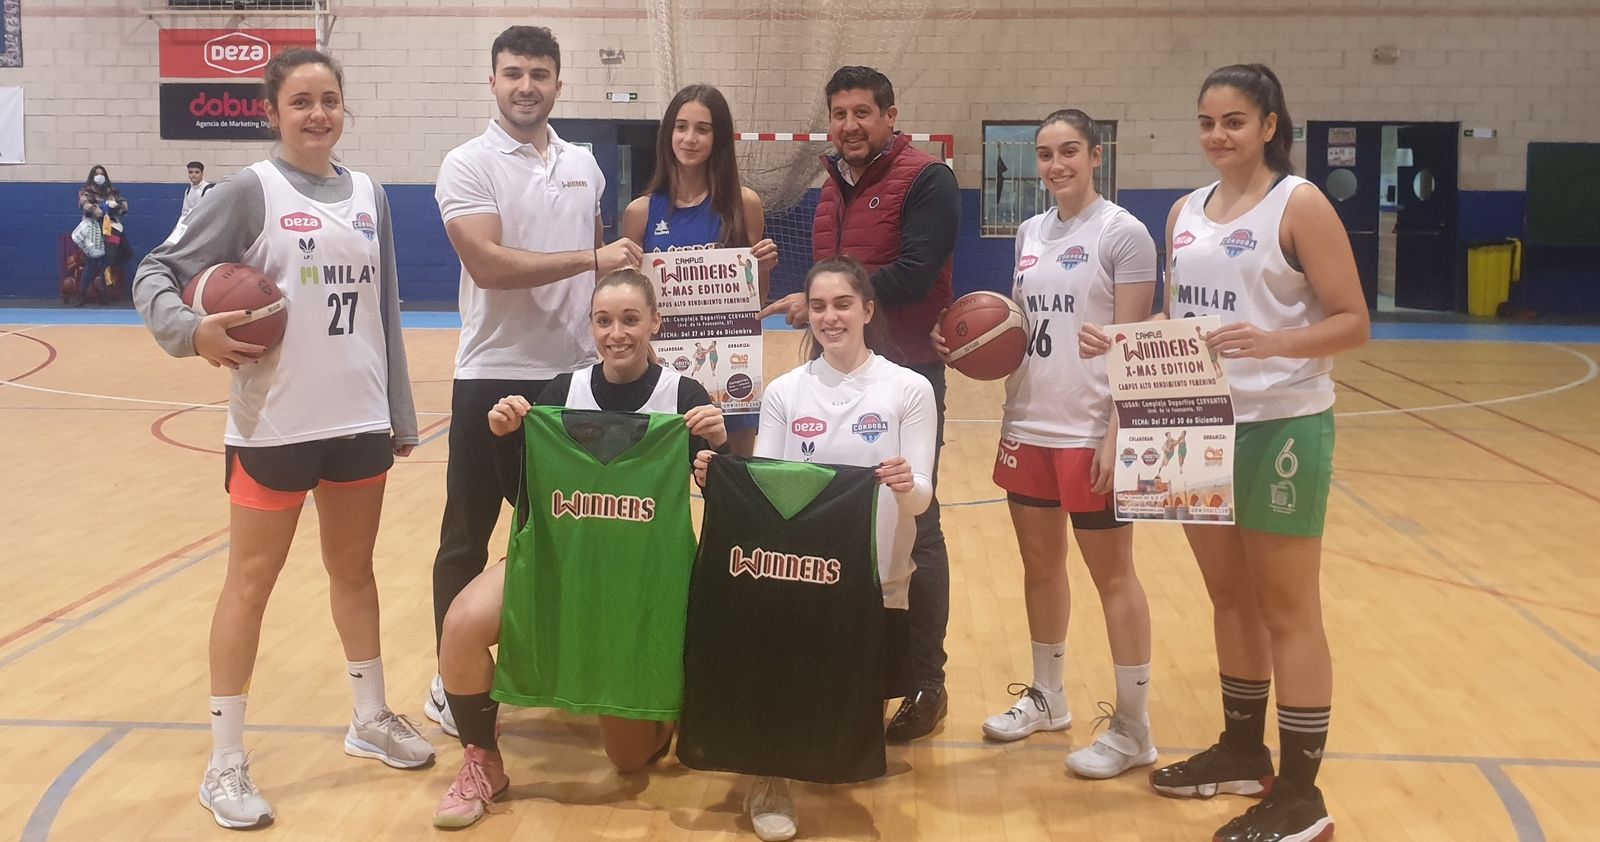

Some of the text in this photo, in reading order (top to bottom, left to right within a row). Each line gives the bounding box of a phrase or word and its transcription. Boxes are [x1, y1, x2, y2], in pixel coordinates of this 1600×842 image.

[196, 120, 220, 129] Agencia
[229, 120, 260, 129] Marketing
[675, 256, 704, 265] CAMPUS
[661, 282, 740, 297] X-MAS EDITION
[1178, 284, 1237, 312] MILAR
[327, 291, 359, 336] 27
[1135, 331, 1162, 340] CAMPUS
[1126, 360, 1204, 377] X-MAS EDITION
[1118, 383, 1138, 391] CAMPUS
[1195, 416, 1223, 424] Diciembre
[1275, 437, 1298, 478] 6
[552, 489, 656, 522] WINNERS
[729, 545, 841, 585] WINNERS
